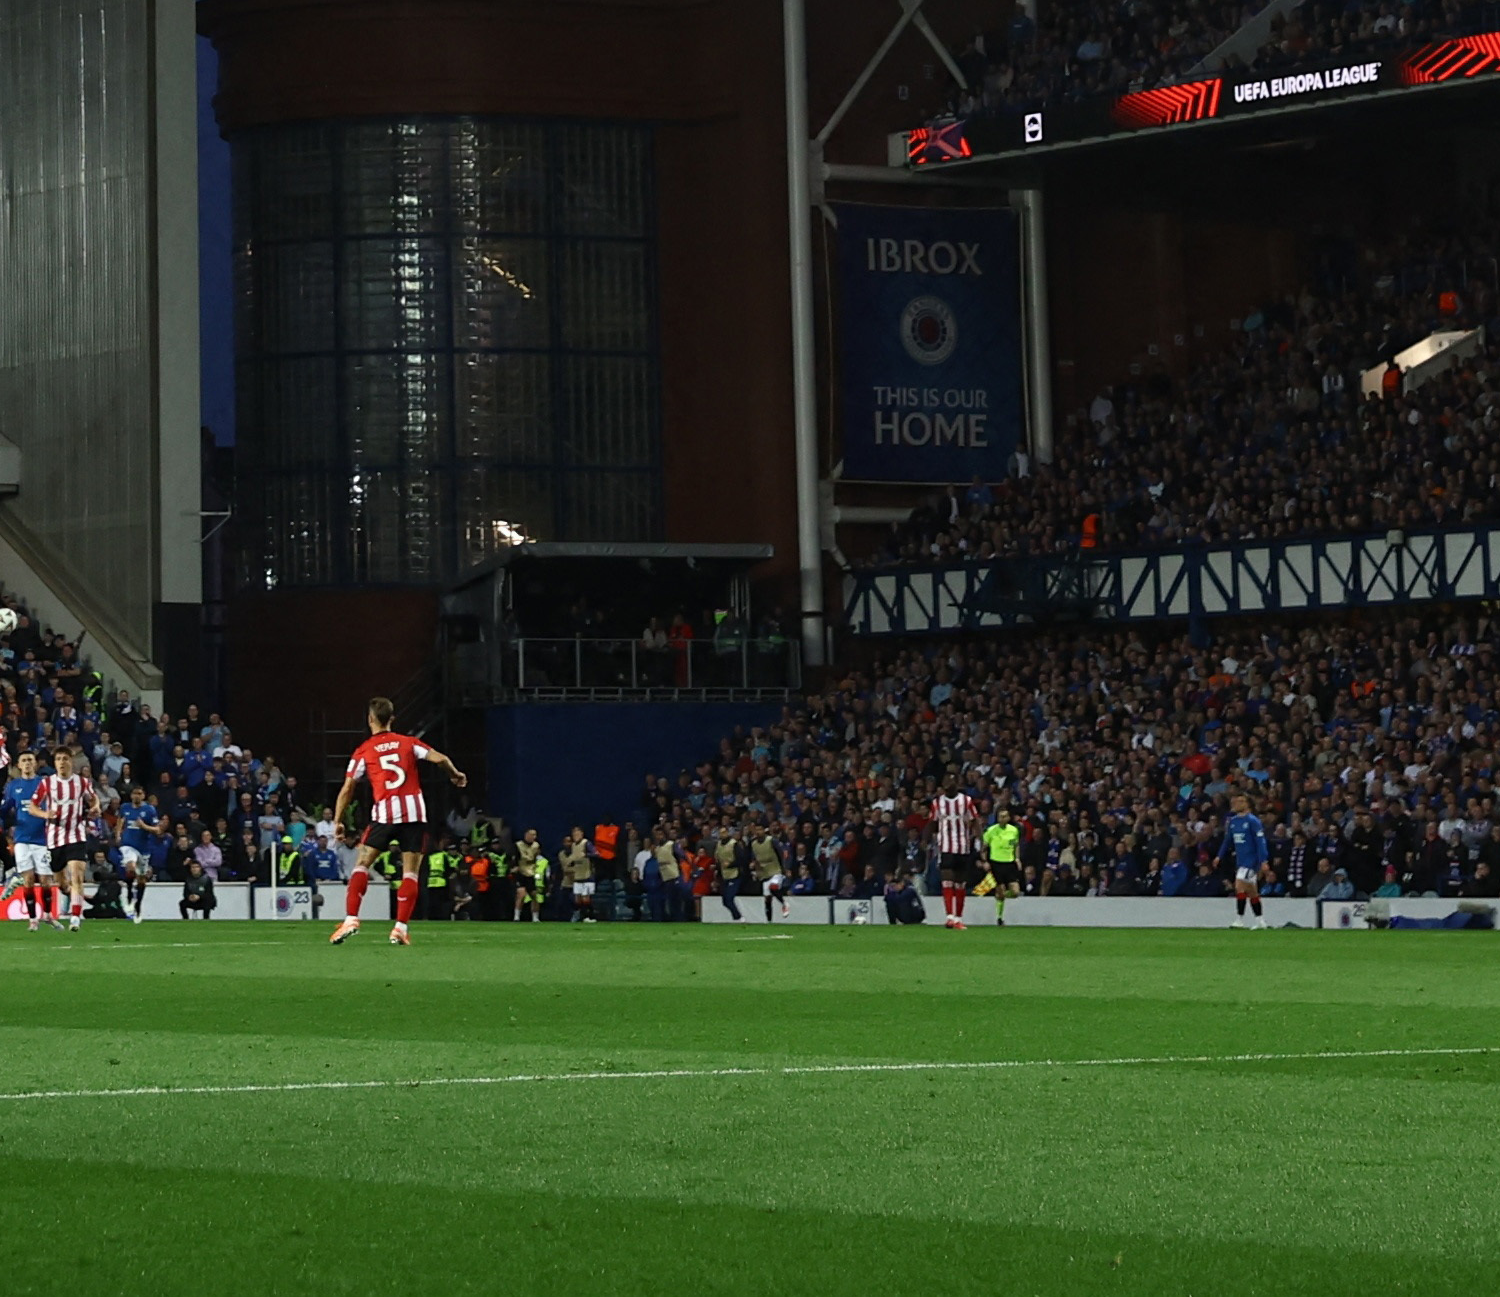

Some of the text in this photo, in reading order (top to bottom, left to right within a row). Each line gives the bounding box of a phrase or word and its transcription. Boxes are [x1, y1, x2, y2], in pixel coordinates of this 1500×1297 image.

[1233, 79, 1269, 103] UEFA
[1271, 71, 1323, 99] EUROPA
[866, 237, 983, 276] IBROX
[872, 386, 989, 409] THIS IS OUR
[873, 409, 989, 447] HOME
[379, 753, 406, 789] 5
[294, 891, 310, 903] 23
